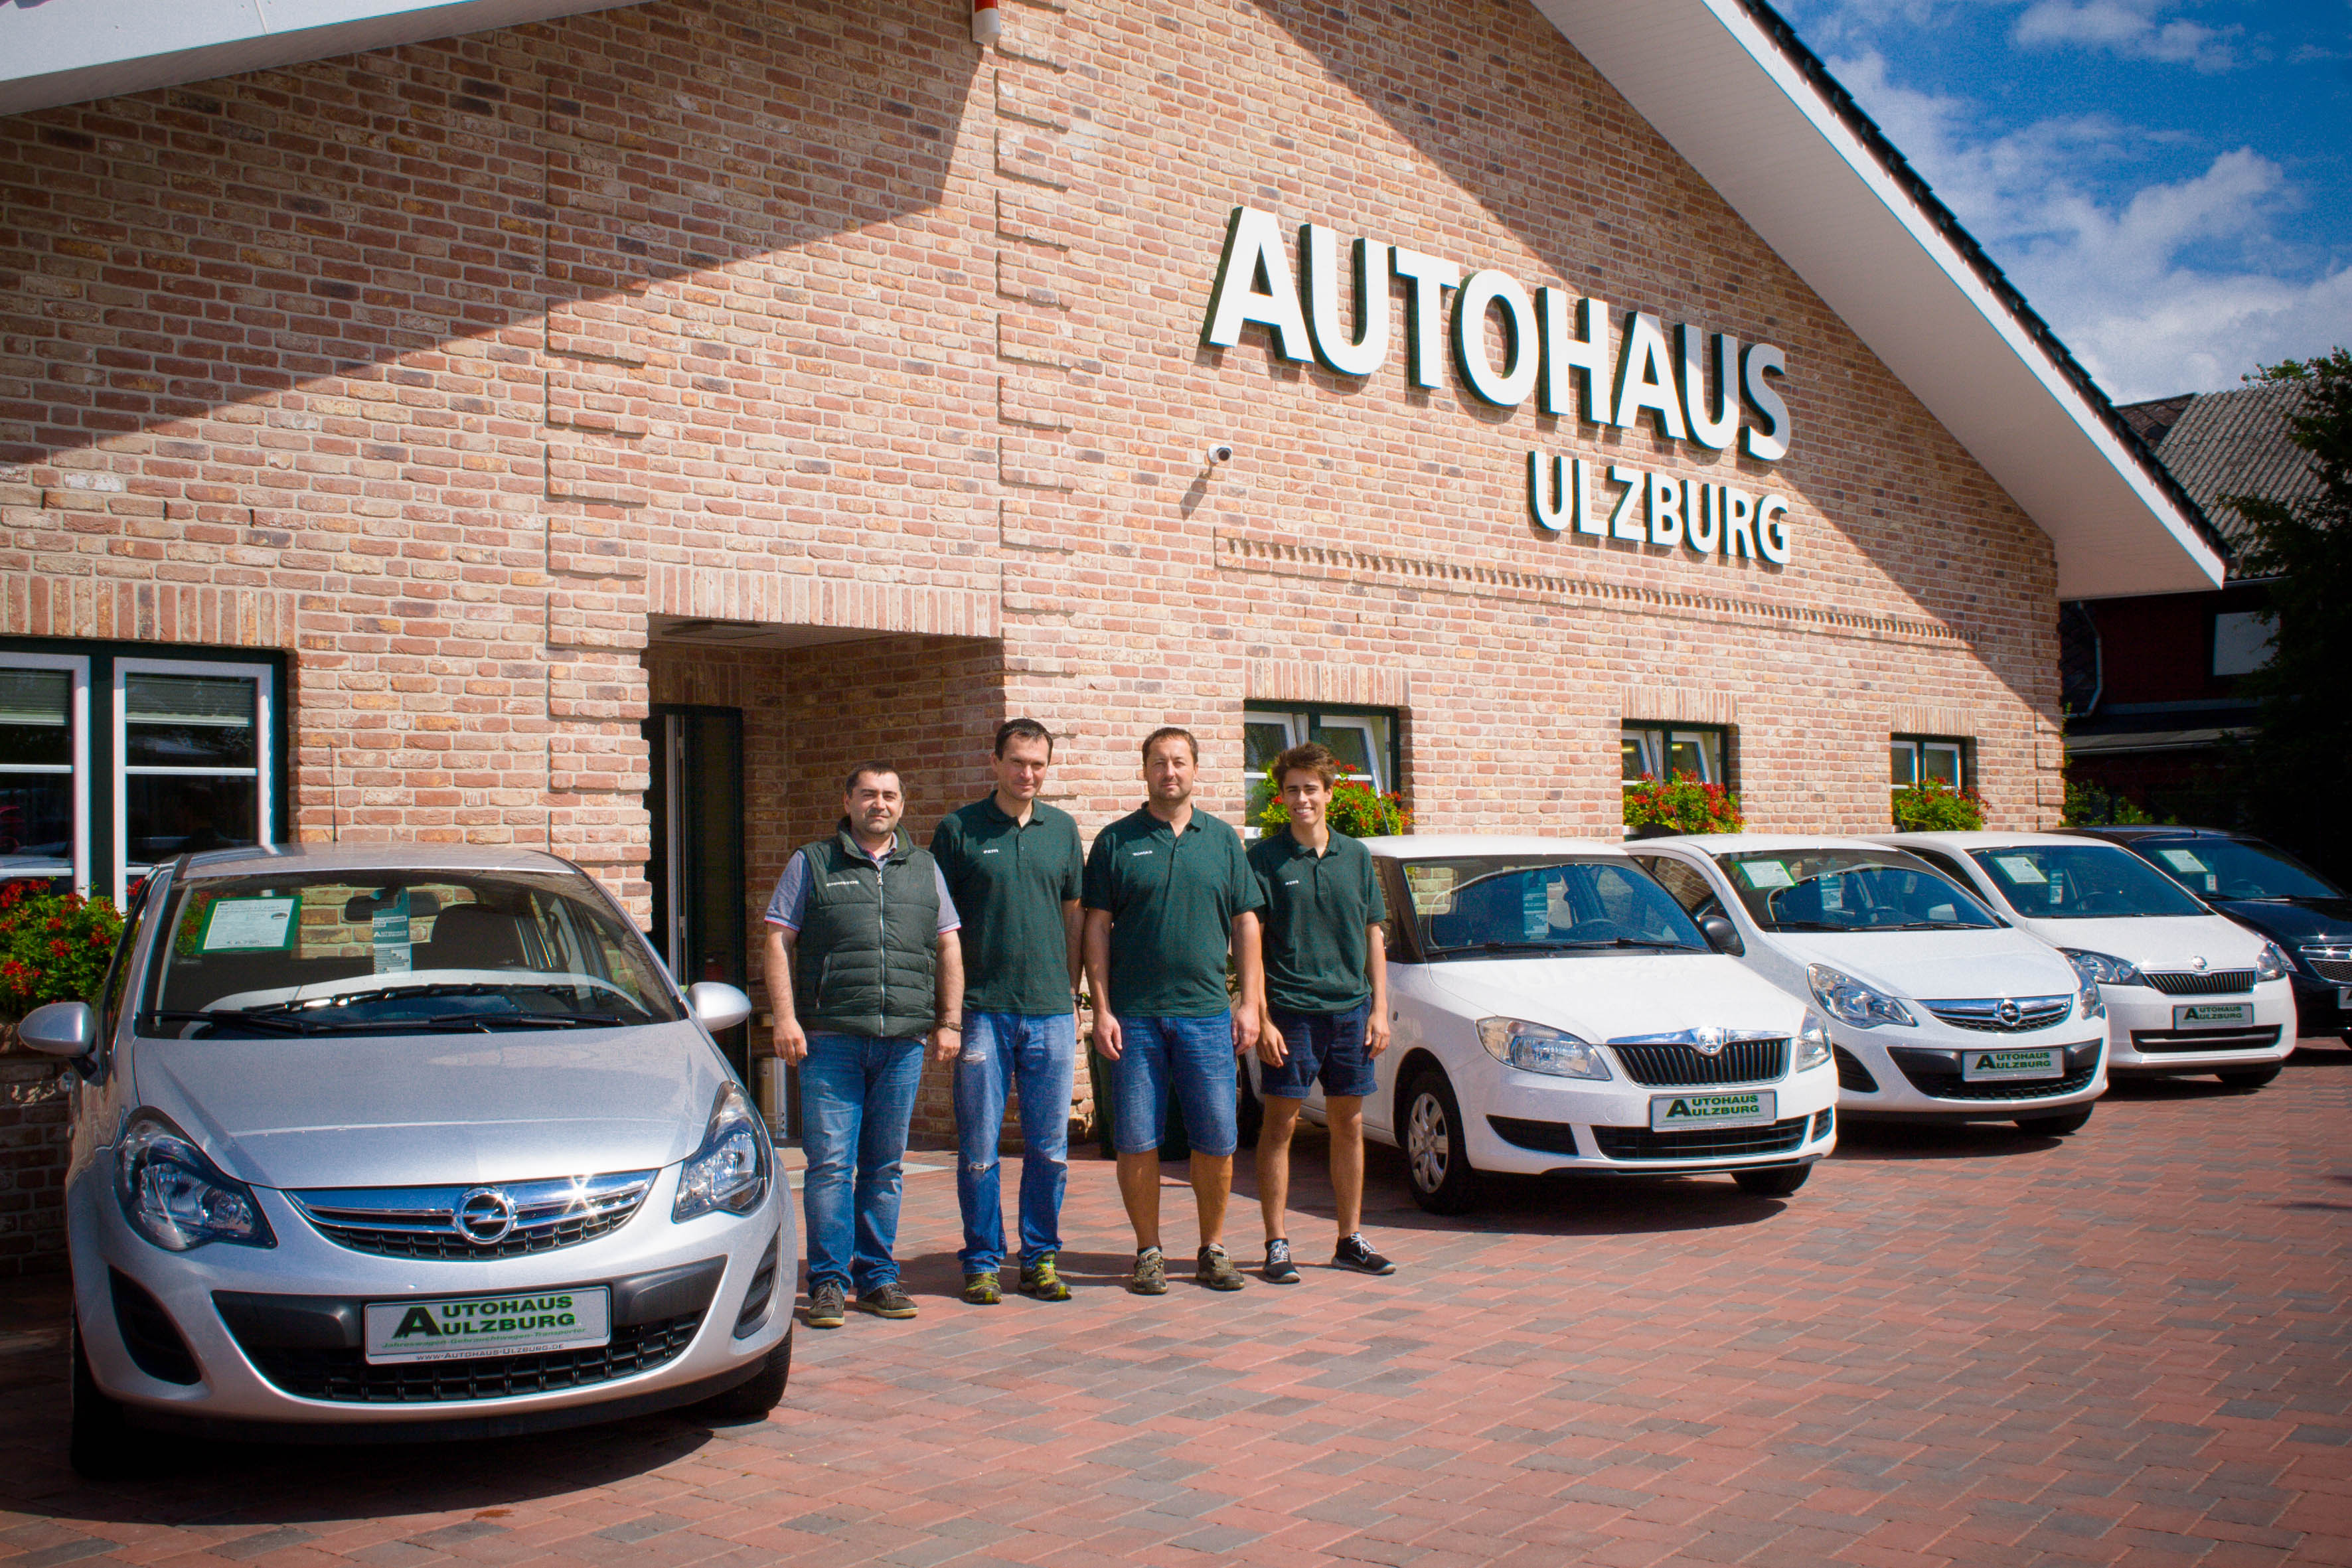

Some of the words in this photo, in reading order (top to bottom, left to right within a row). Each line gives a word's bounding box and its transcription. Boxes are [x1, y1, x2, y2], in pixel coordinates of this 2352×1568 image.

[1202, 206, 1792, 461] AUTOHAUS
[1528, 450, 1791, 565] ULZBURG
[1975, 1052, 2050, 1069] AUTOHAUS
[1996, 1060, 2051, 1069] ULZBURG
[1666, 1095, 1759, 1117] AUTOHAUS
[1691, 1105, 1759, 1116] ULZBURG
[392, 1295, 573, 1339] AUTOHAUS
[442, 1312, 576, 1336] ULZBURG
